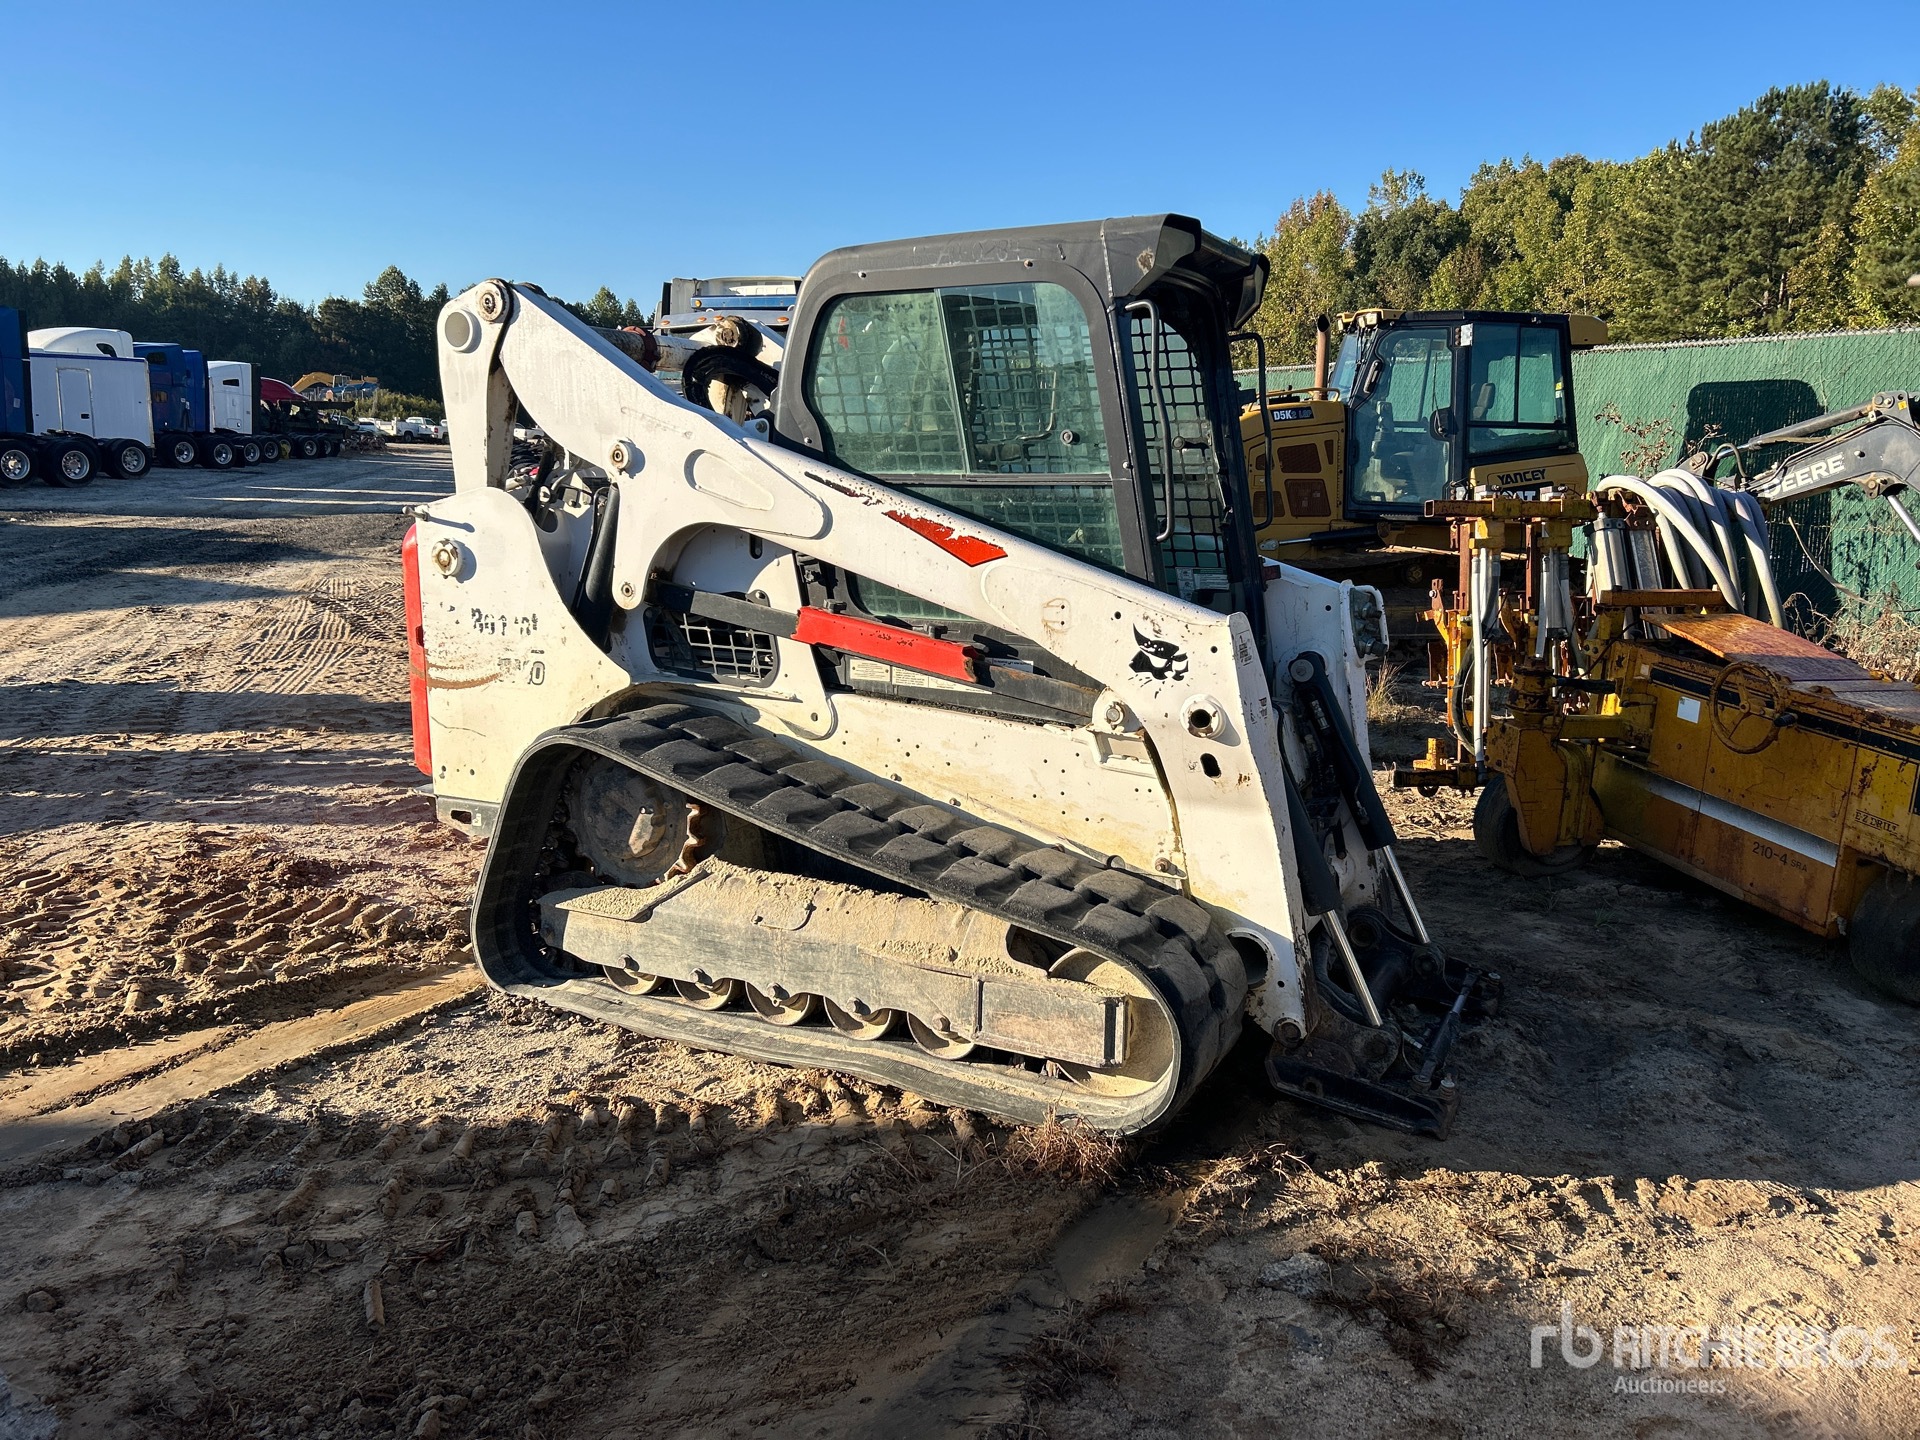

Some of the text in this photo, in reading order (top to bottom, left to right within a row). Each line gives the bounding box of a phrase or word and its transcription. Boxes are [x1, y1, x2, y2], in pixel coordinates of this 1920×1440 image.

[1273, 409, 1297, 421] D5K2
[1497, 469, 1546, 485] YANCEY
[1758, 453, 1845, 498] DEERE
[1752, 841, 1808, 872] 210-4 SRA
